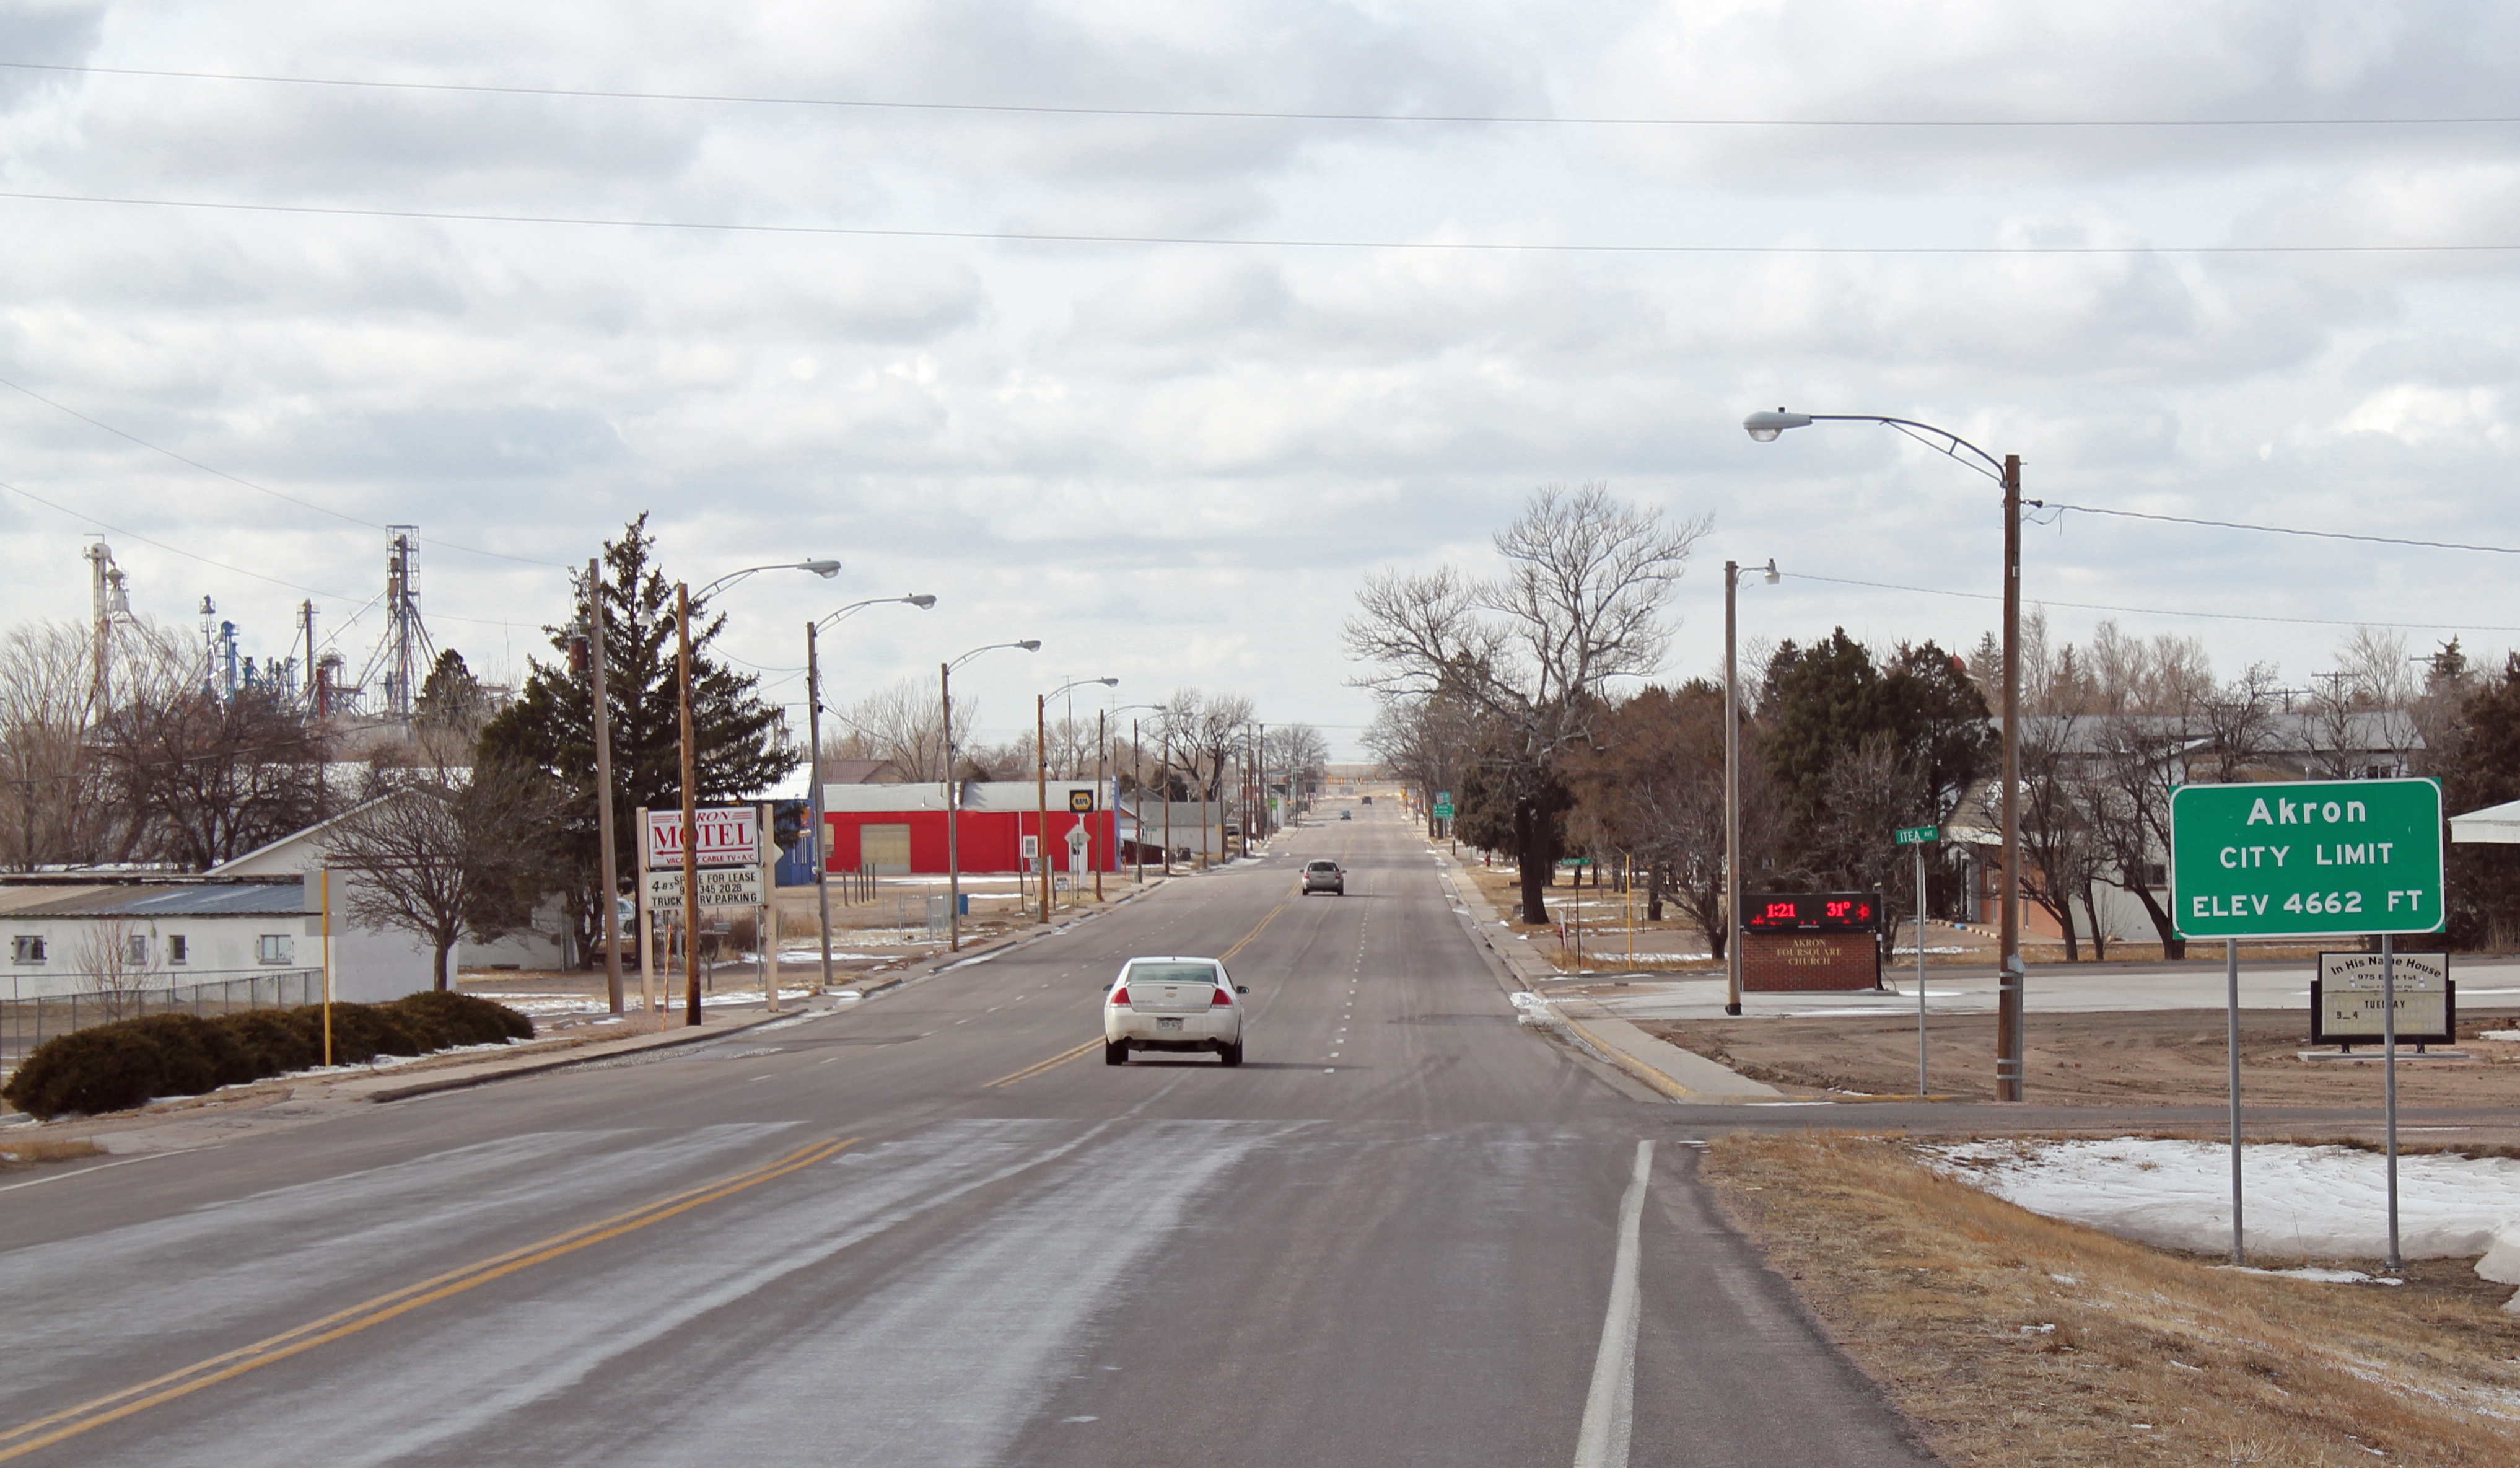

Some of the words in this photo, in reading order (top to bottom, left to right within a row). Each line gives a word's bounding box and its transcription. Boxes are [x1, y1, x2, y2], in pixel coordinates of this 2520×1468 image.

[1075, 798, 1088, 806] NAPA
[672, 811, 731, 824] ARON
[2246, 797, 2366, 825] Akron
[1900, 830, 1920, 842] ITEA
[667, 856, 700, 864] VACAY
[2220, 845, 2290, 869] CITY
[2317, 842, 2394, 866] LIMIT
[674, 875, 703, 885] SPE
[707, 874, 724, 884] FOR
[728, 872, 756, 882] LEASE
[699, 885, 715, 894] 345
[720, 884, 742, 893] 2028
[652, 897, 682, 907] TRUCK
[700, 895, 712, 905] RV
[715, 894, 757, 903] PARKING
[2192, 894, 2269, 918] ELEV
[2283, 891, 2362, 914] 4662
[2387, 890, 2423, 912] FT
[1767, 903, 1796, 918] 1:21
[1793, 939, 1826, 947] AKRON
[1777, 947, 1842, 957] FOURSQUARE
[2330, 967, 2343, 975] In
[2345, 959, 2365, 970] His
[2368, 956, 2402, 965] Nae
[2406, 959, 2441, 978] House
